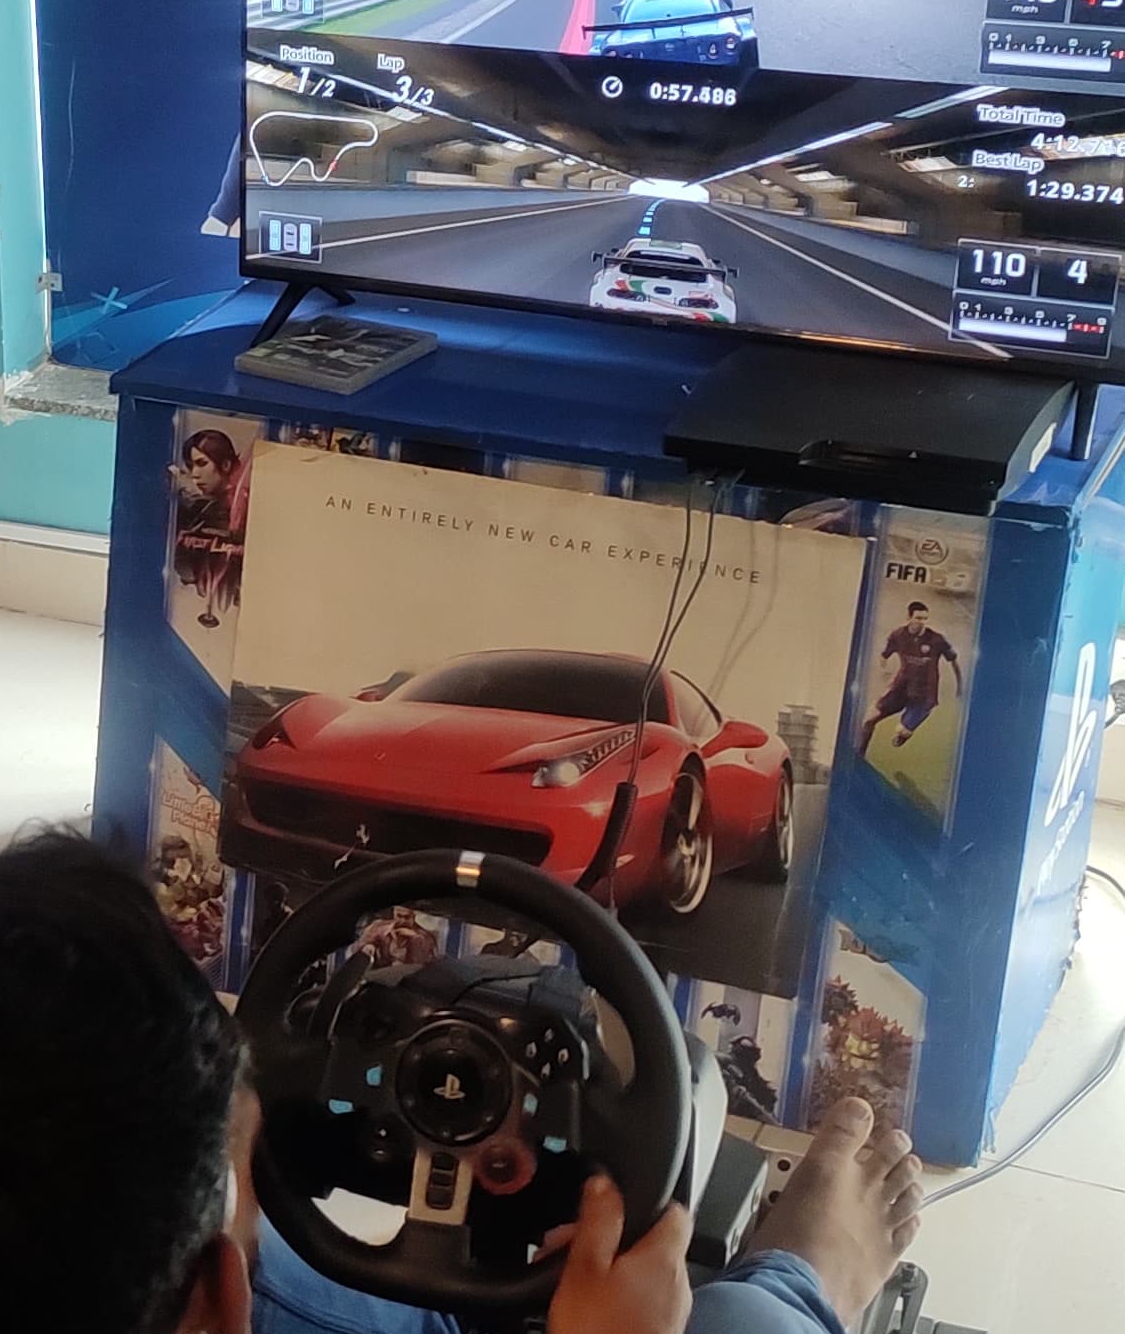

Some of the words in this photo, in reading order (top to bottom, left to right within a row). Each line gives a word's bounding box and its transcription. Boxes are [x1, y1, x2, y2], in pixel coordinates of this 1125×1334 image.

[1011, 5, 1039, 14] mph
[280, 45, 335, 64] Position
[377, 53, 405, 74] Lap
[298, 67, 336, 98] 1/2
[396, 75, 435, 106] 3/3
[977, 104, 1020, 124] Total
[1023, 108, 1066, 127] Time
[972, 149, 1012, 168] Best
[1013, 153, 1045, 174] Lap
[1026, 179, 1124, 205] 1:29.374
[972, 249, 1026, 278] 110
[1067, 259, 1088, 284] 4
[980, 277, 1007, 286] mph
[325, 496, 352, 511] AN
[367, 501, 475, 533] ENTIRELY
[488, 523, 536, 544] NEW
[549, 534, 594, 554] CAR
[607, 544, 762, 584] EXPERIENCE
[885, 562, 928, 585] FIFA
